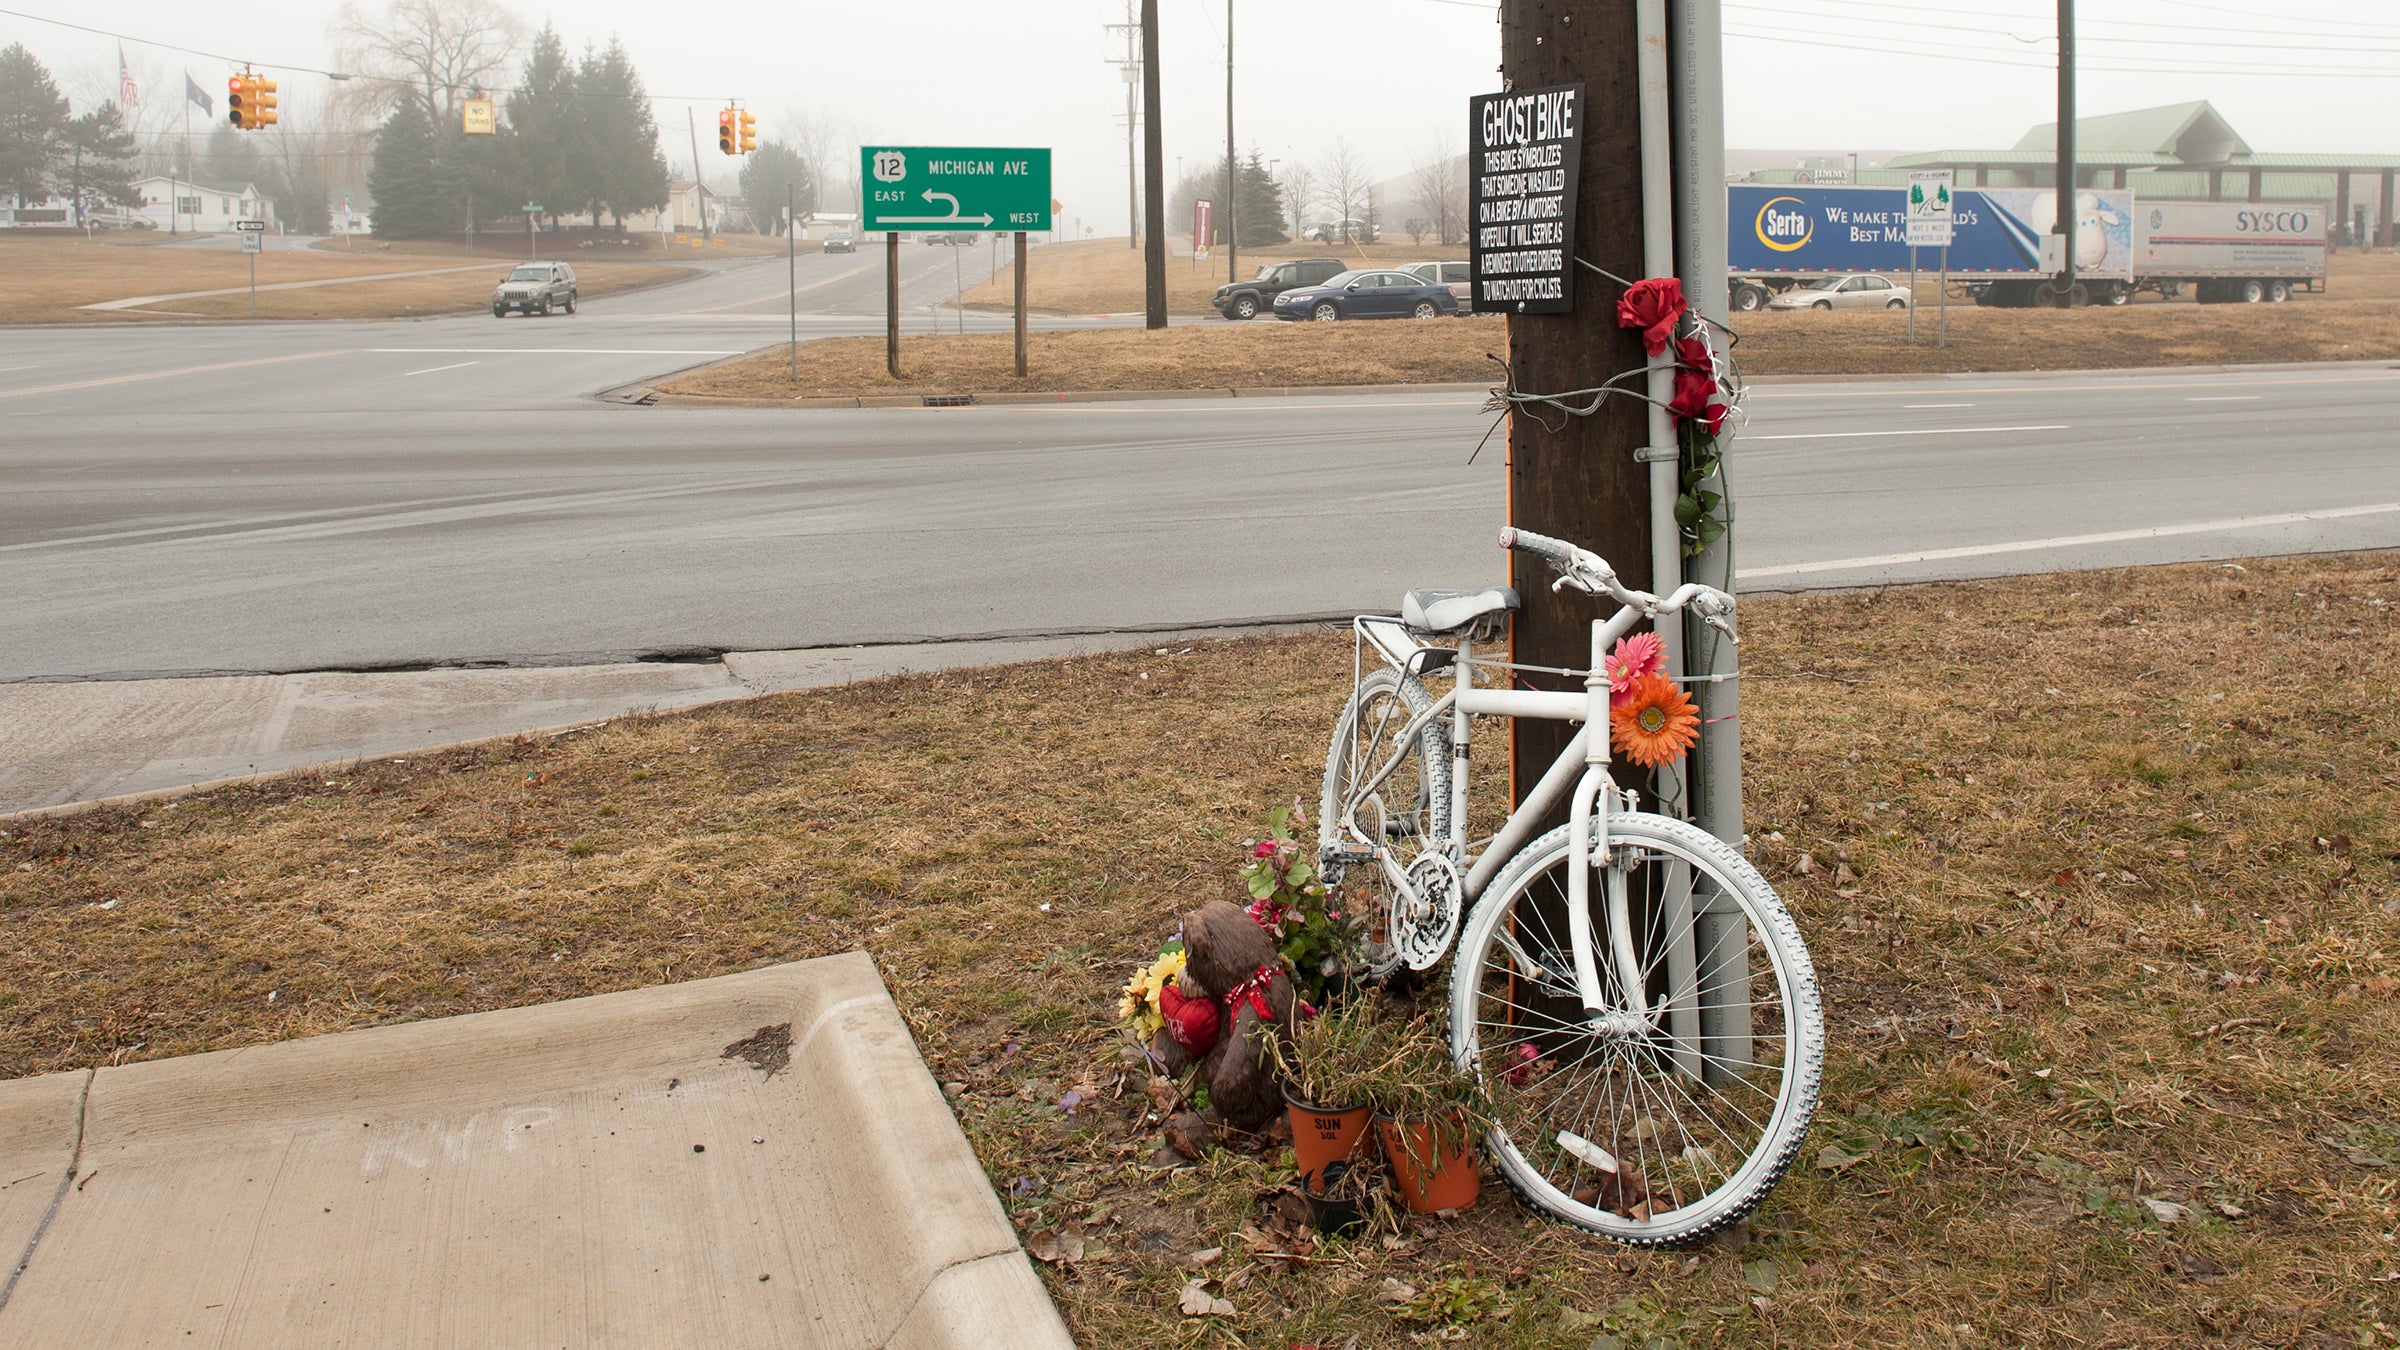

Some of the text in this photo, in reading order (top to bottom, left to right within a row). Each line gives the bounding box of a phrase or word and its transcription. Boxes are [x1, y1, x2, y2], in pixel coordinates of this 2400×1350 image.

[1686, 3, 1695, 25] RIGID
[1687, 50, 1696, 77] LISTED
[471, 108, 484, 116] NO
[1483, 89, 1575, 147] GHOST BIKE
[1690, 127, 1698, 141] MAX
[880, 159, 1028, 176] 12 MICHIGAN AVE
[1484, 144, 1562, 173] THIS BIKE SYMBOLIZES
[1690, 146, 1699, 185] RESISTANT
[1481, 169, 1564, 197] THAT SOMEONE WAS KILLED
[1814, 170, 1849, 179] JIMMY
[875, 191, 905, 202] EAST
[1691, 190, 1700, 224] SUNLIGHT
[1010, 213, 1039, 223] WEST
[1480, 195, 1563, 223] ON A BIKE BY A MOTORIST.
[1892, 213, 1907, 224] TH
[1767, 208, 1805, 236] Serta
[2236, 211, 2309, 233] SYSCO
[1480, 222, 1563, 248] HOPEFULLY IT WILL SERVE AS
[1692, 229, 1700, 259] CONDUIT
[1481, 248, 1562, 274] A REMINDER TO OTHER DRIVERS
[1482, 277, 1563, 301] TO WATCH OUT FOR CYCLISTS.
[1693, 281, 1701, 302] RIGID
[1314, 1117, 1341, 1131] SUN
[1320, 1131, 1338, 1140] SOL
